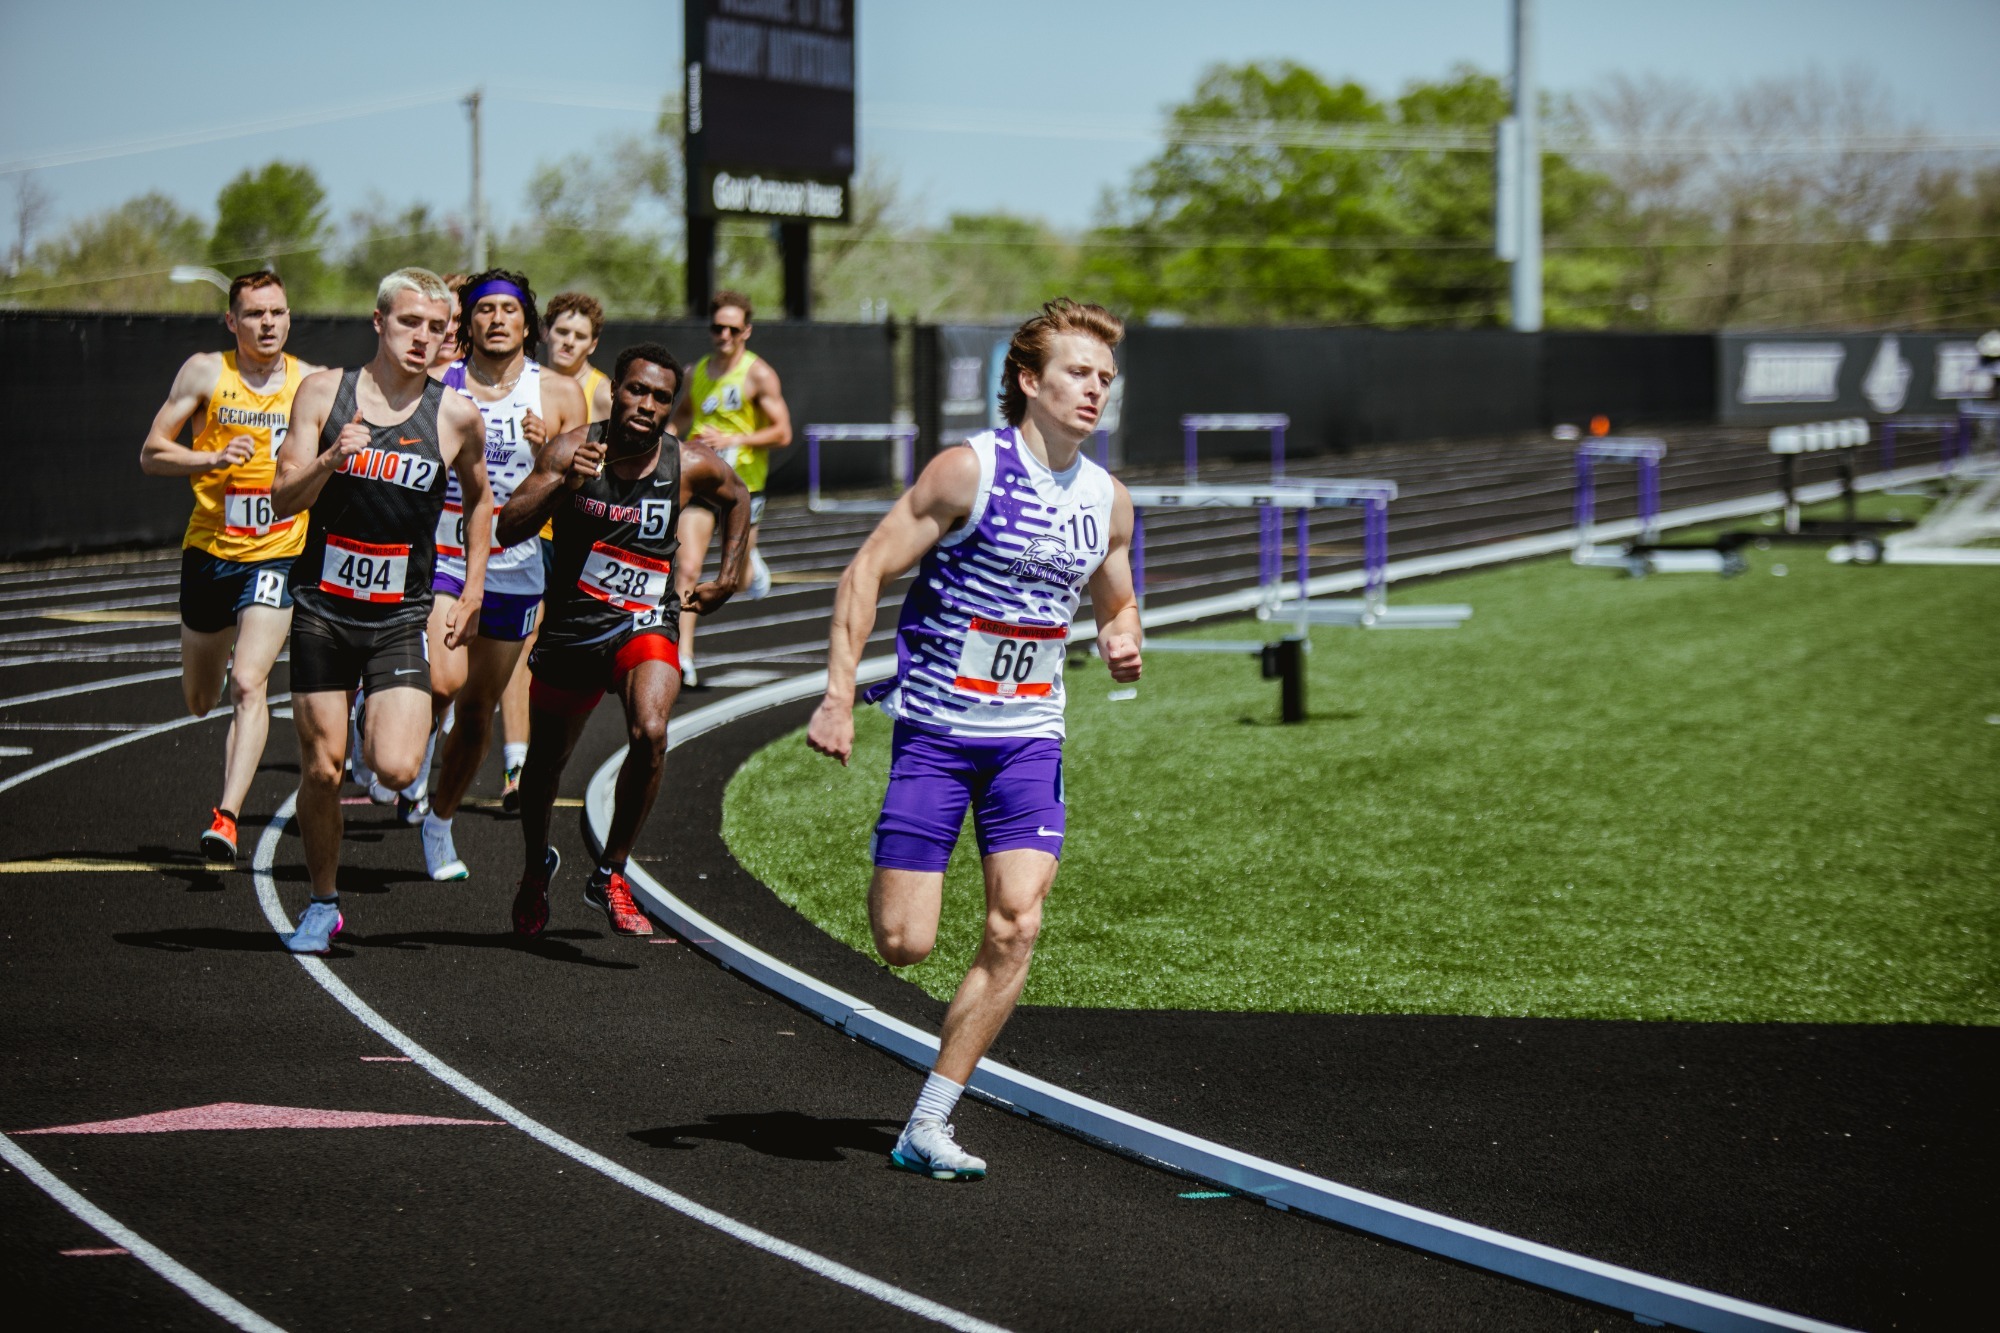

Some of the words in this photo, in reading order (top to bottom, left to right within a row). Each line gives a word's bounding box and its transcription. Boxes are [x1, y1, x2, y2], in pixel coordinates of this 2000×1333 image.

[402, 458, 432, 490] 12
[242, 496, 282, 526] 16
[575, 494, 606, 517] RED
[643, 503, 665, 536] 5
[1067, 513, 1098, 551] 10
[336, 540, 361, 552] ASBURY
[362, 544, 402, 557] UNIVERSITY
[338, 554, 391, 591] 494
[599, 561, 649, 598] 238
[1008, 558, 1084, 585] ASBURY
[258, 574, 278, 603] 2
[526, 606, 538, 633] 11
[980, 622, 1017, 635] ASBURY
[1018, 627, 1059, 640] UNIVERSITY
[990, 639, 1039, 684] 66
